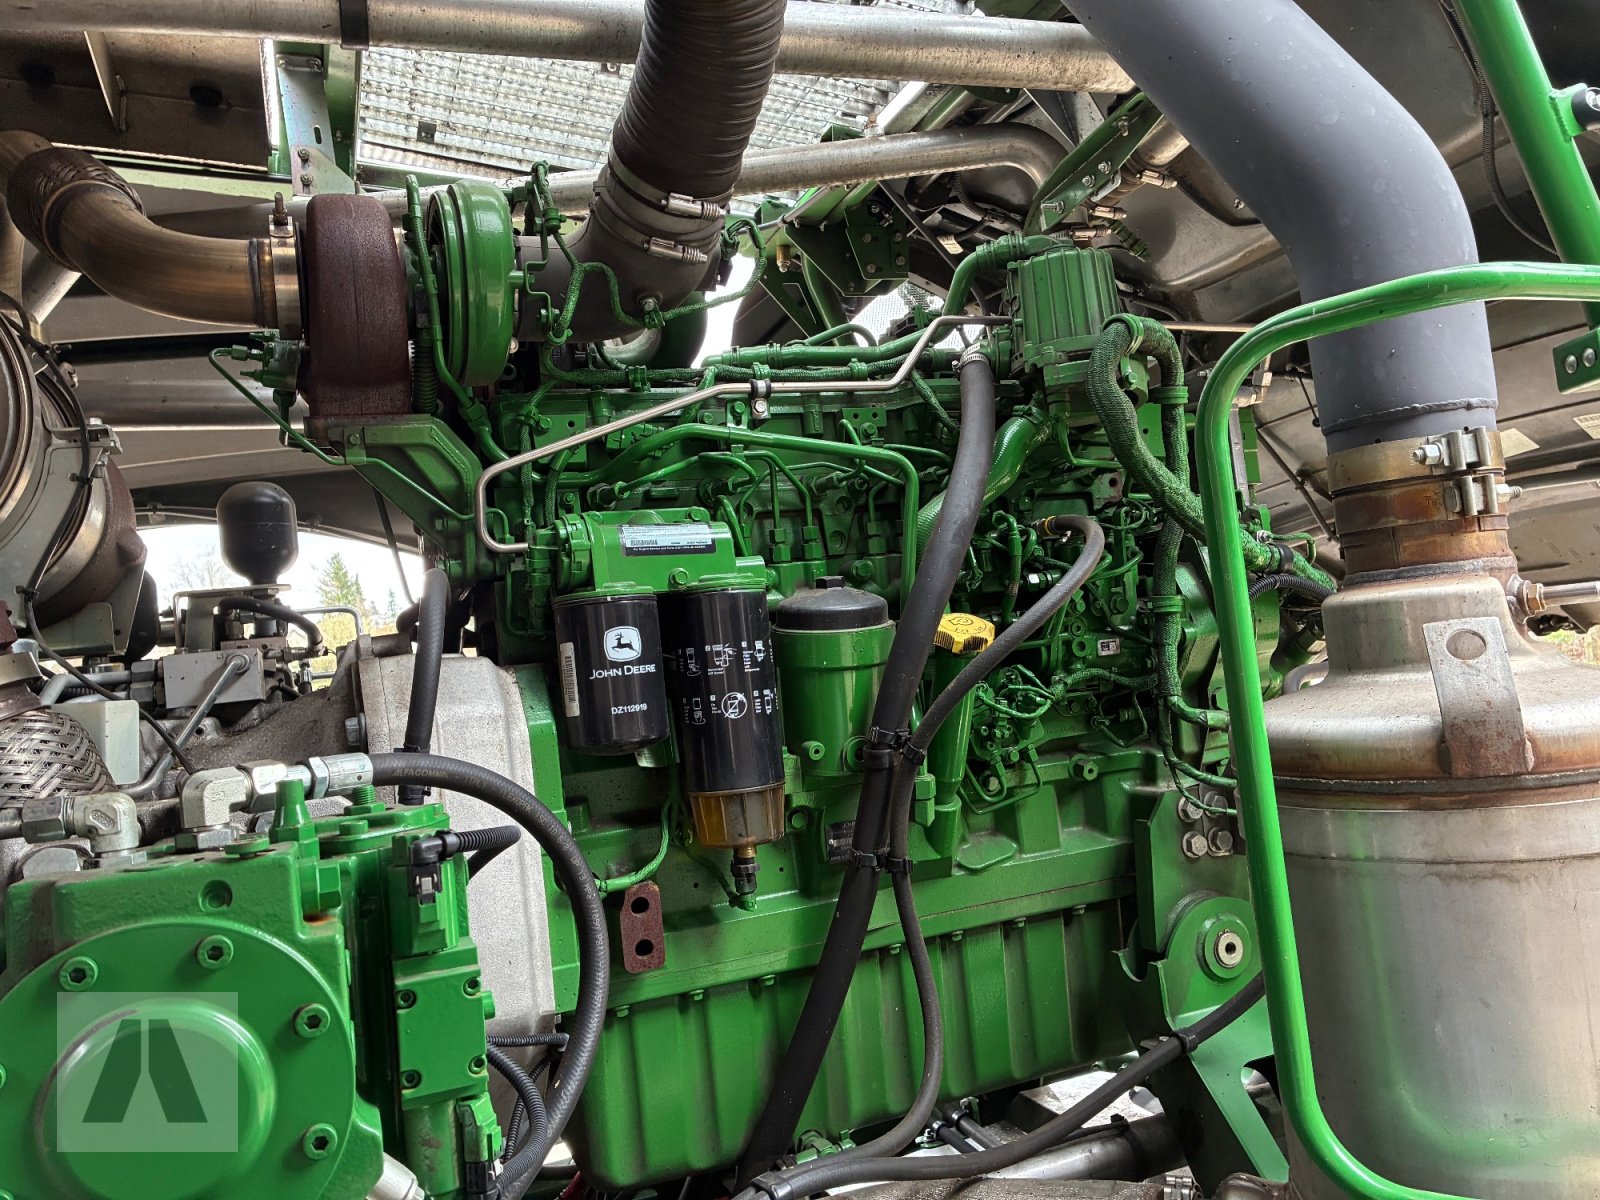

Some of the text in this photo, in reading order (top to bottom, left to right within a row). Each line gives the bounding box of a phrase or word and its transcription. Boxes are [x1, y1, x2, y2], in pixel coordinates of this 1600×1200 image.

[589, 664, 656, 680] JOHN DEERE
[611, 703, 647, 715] DZ112919
[391, 769, 449, 779] ALFAGOMMA
